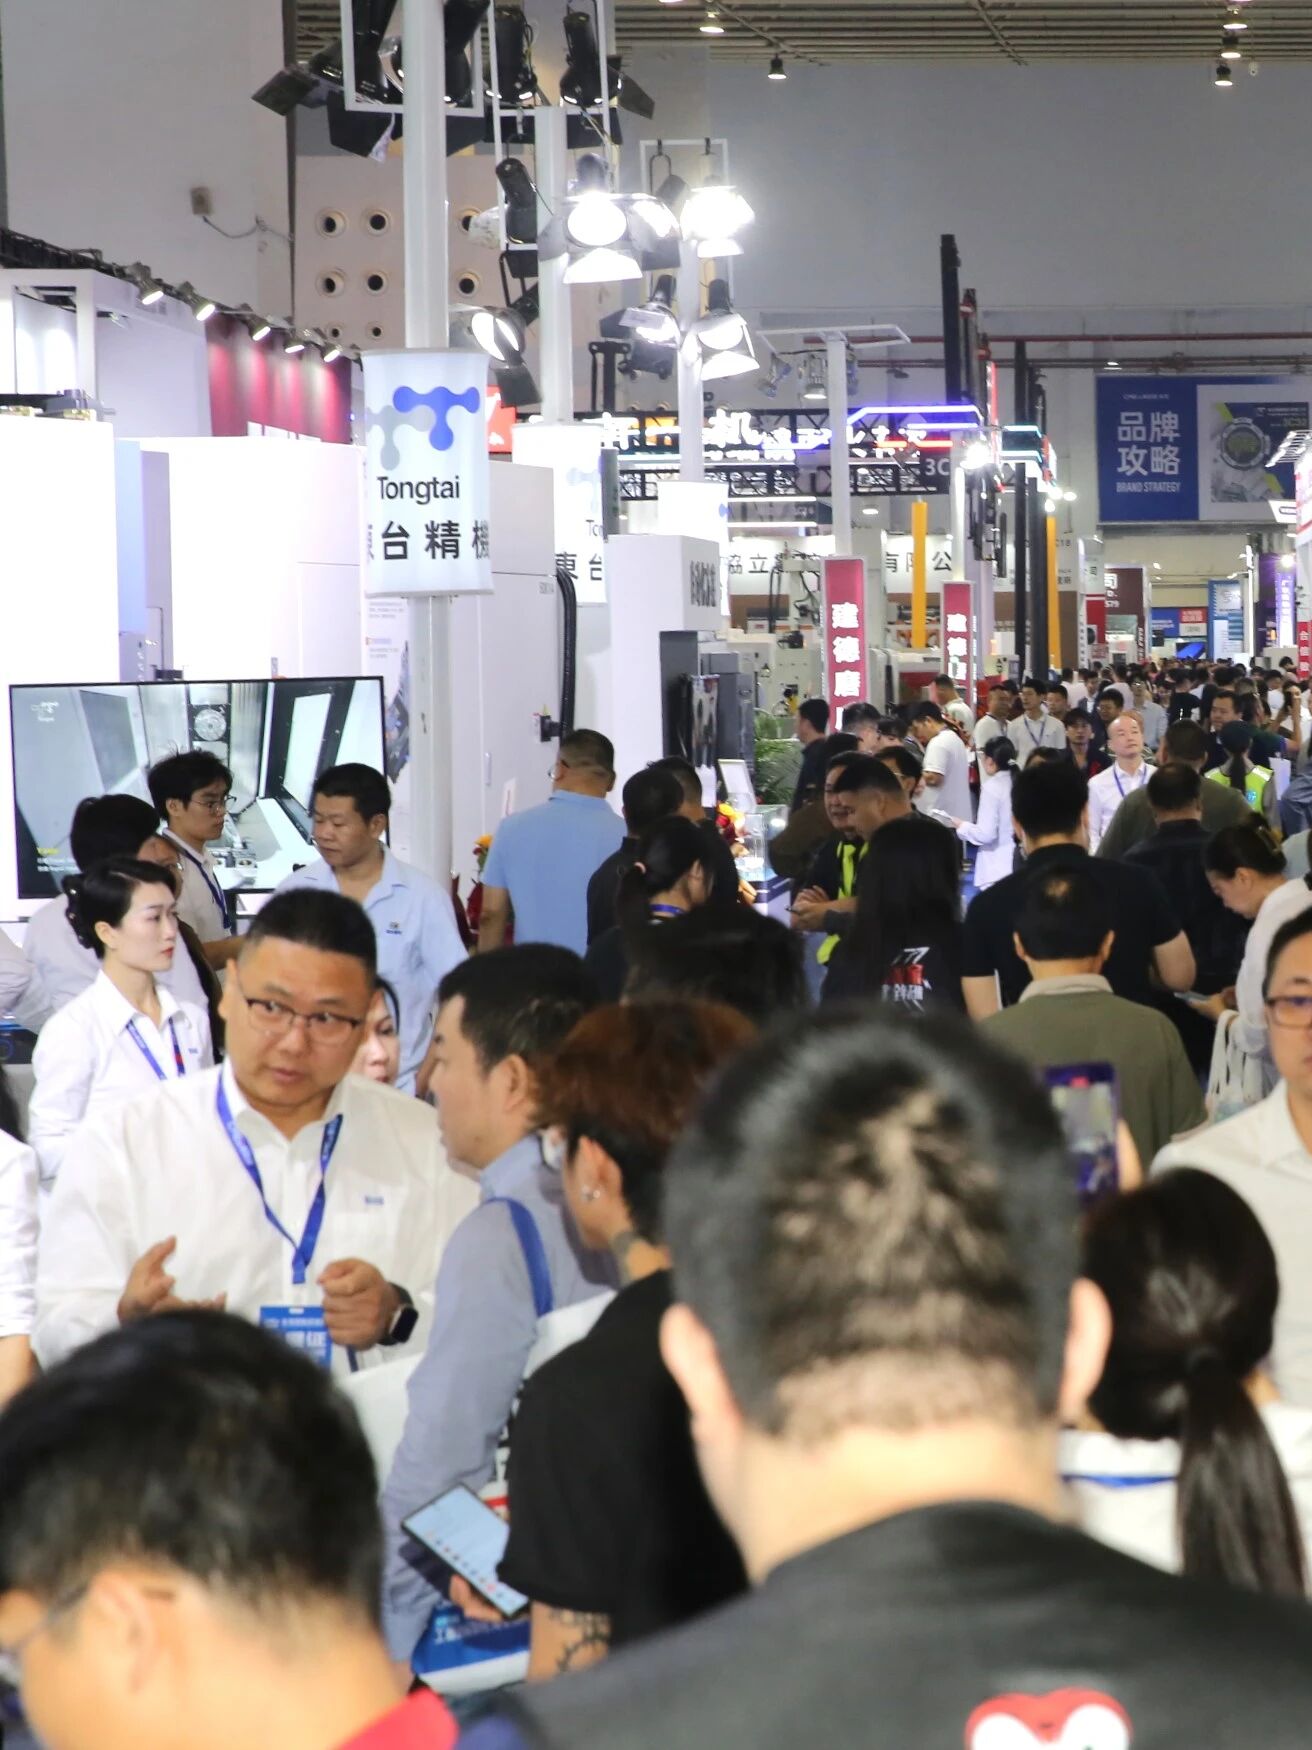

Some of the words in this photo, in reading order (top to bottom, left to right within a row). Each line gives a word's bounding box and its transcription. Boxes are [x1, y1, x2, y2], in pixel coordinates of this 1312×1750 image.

[1117, 411, 1181, 442] 品牌
[1117, 445, 1181, 476] 攻略
[377, 475, 460, 505] Tongtai
[1116, 482, 1143, 493] BRAND
[1144, 482, 1181, 493] STRATEGY
